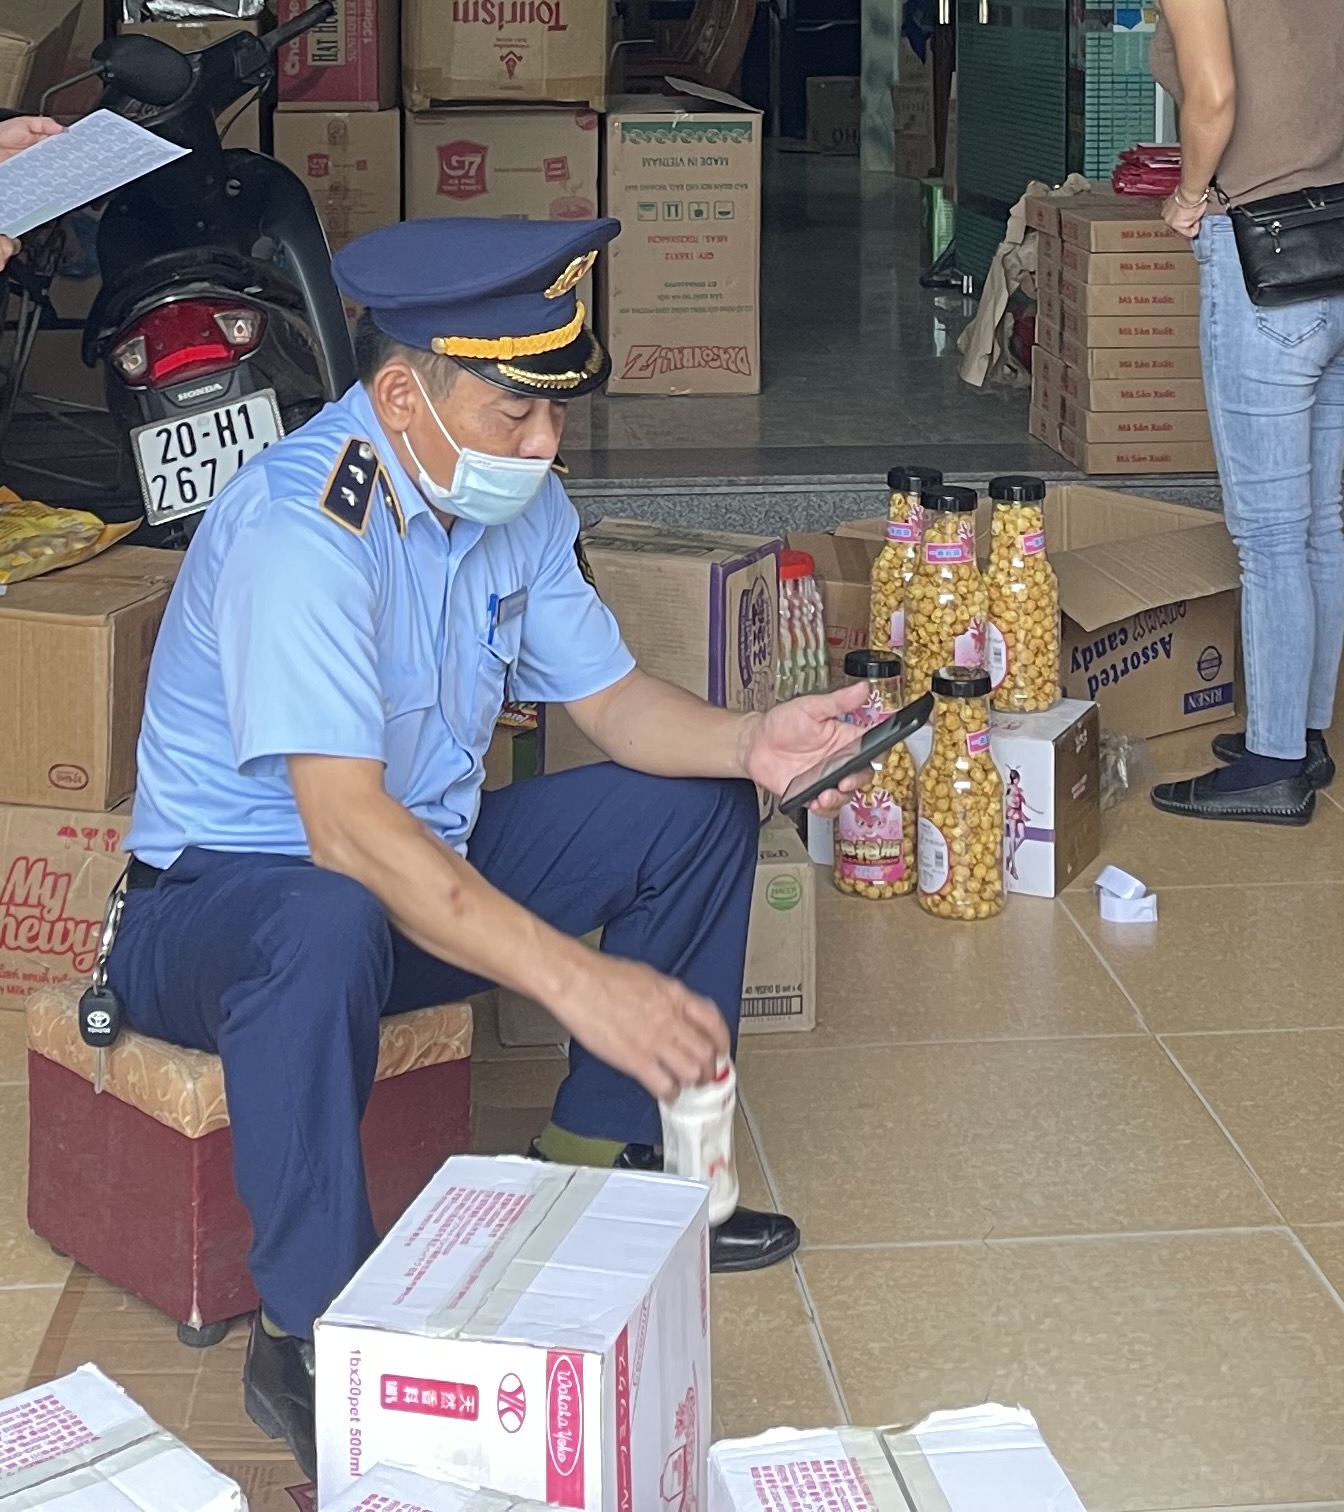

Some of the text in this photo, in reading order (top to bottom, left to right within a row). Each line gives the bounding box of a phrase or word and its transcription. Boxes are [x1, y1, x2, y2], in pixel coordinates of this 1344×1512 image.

[452, 0, 570, 32] Tourism
[176, 382, 224, 402] HONDA
[155, 403, 256, 466] 20-H1
[1087, 634, 1174, 698] Assorted
